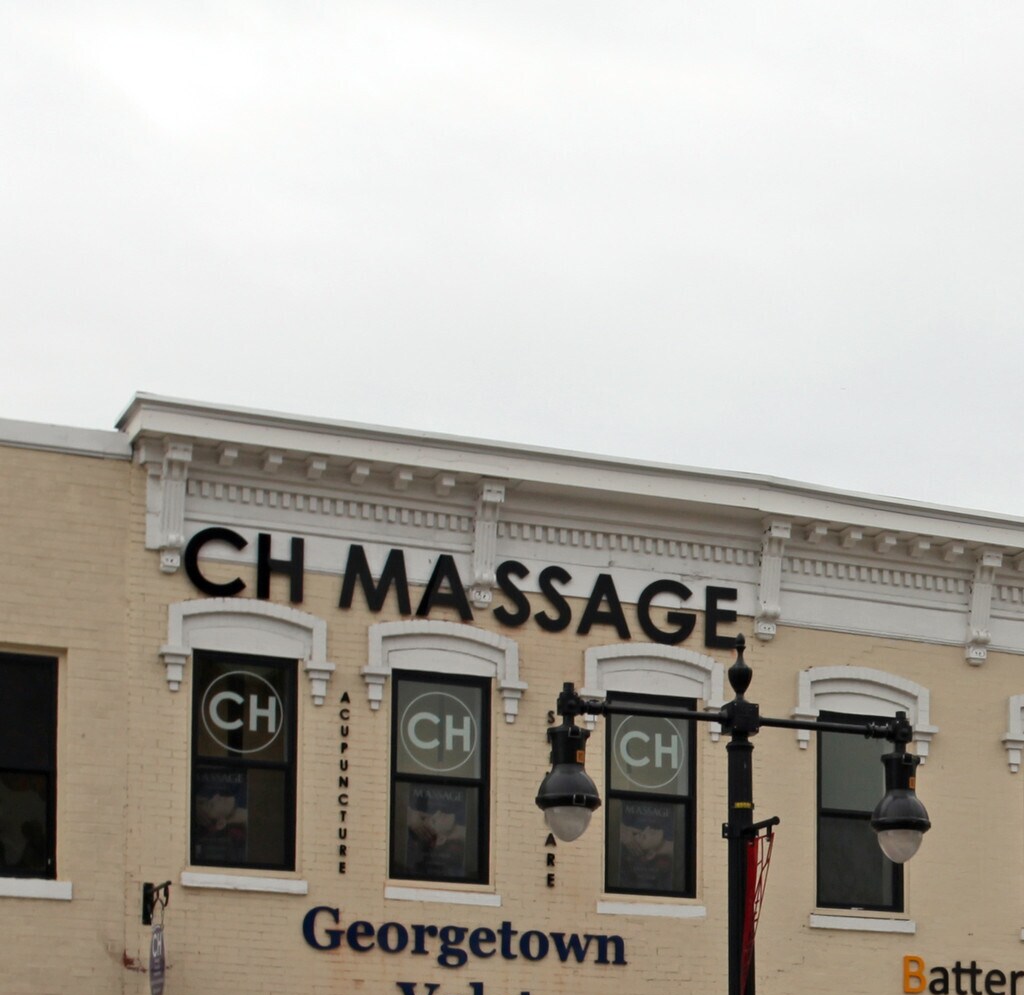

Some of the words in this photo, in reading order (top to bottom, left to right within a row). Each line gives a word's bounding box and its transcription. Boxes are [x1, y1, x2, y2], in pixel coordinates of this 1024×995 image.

[184, 527, 305, 604] CH
[338, 543, 738, 649] MASSAGE
[209, 691, 277, 733] CH
[407, 711, 471, 752] CH
[619, 730, 678, 770] CH
[338, 690, 350, 874] ACUPUNCTURE
[302, 906, 627, 968] Georgetown
